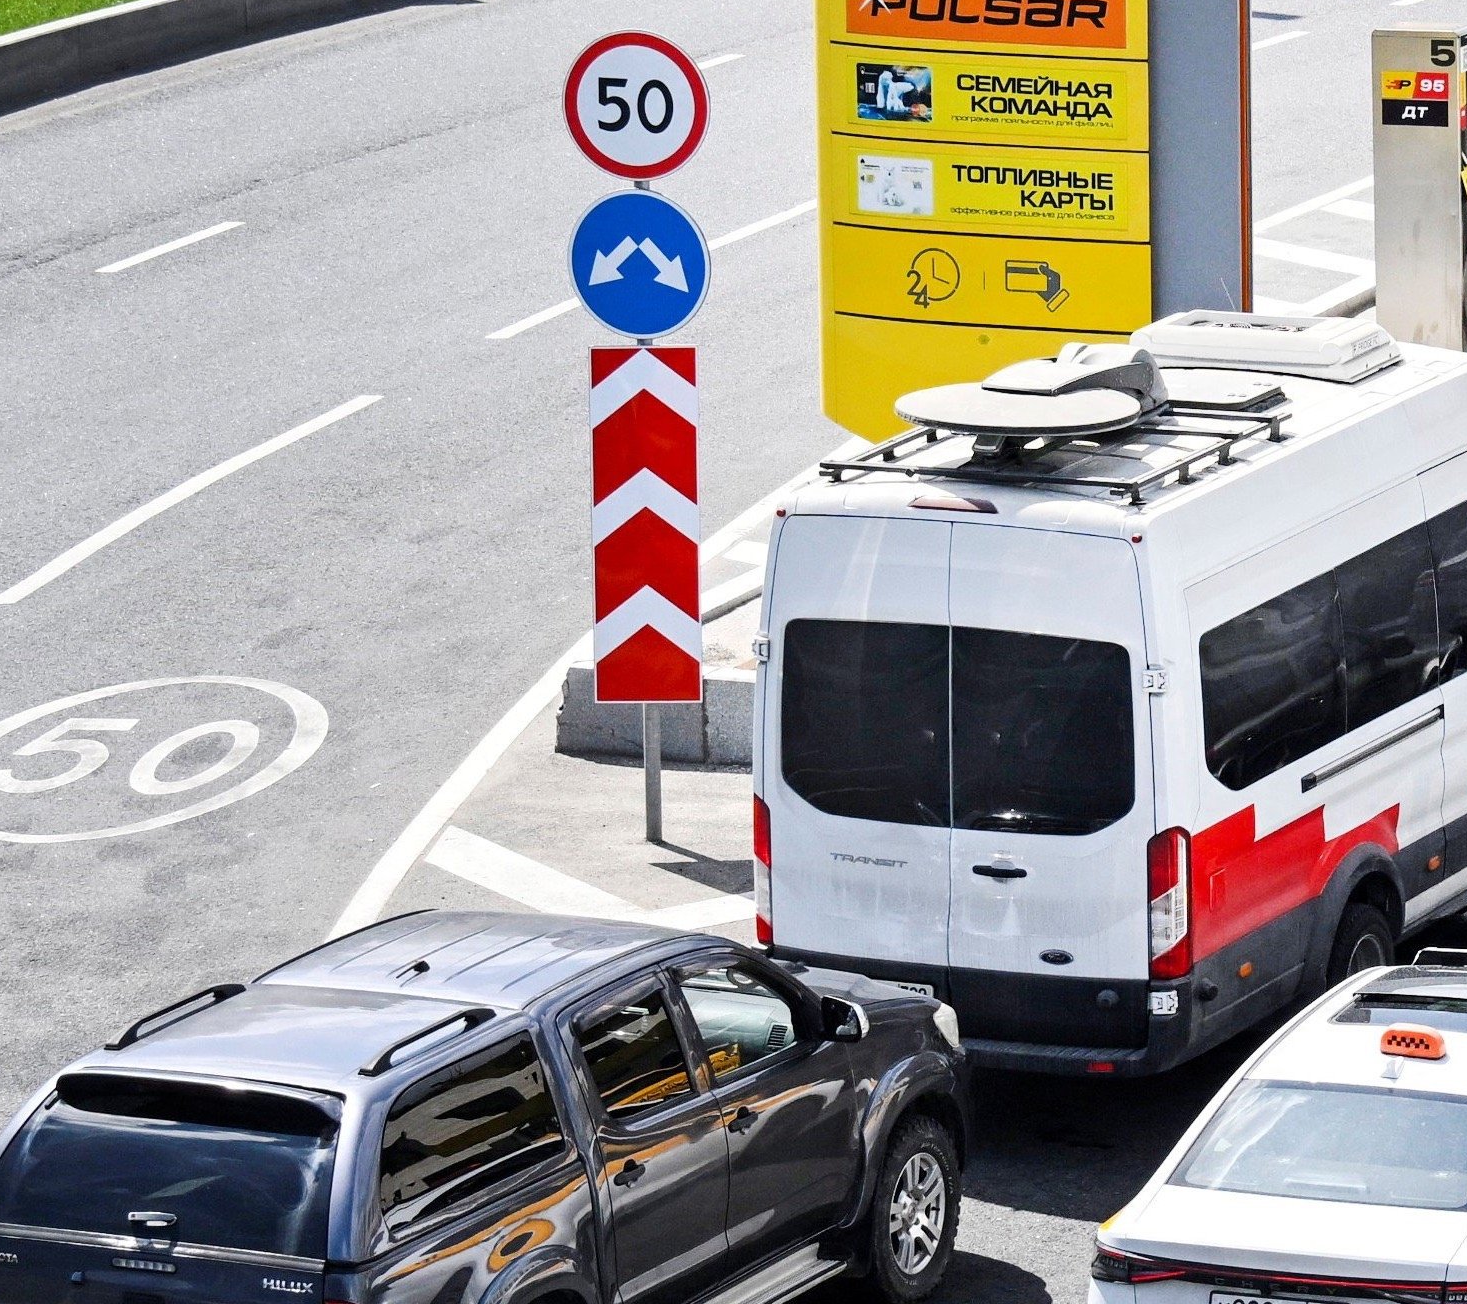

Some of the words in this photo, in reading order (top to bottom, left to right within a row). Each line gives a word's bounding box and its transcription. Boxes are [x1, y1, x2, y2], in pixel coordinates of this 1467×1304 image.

[1430, 39, 1456, 67] 5
[956, 74, 1112, 99] СЕМЕЙНАЯ
[1419, 79, 1445, 93] 95
[597, 77, 674, 134] 50
[971, 95, 1113, 121] КОМАНДА
[1401, 105, 1429, 120] ДТ
[951, 164, 1113, 190] ТОПЛИВНЫЕ
[1020, 189, 1114, 211] КАРТЫ
[907, 270, 930, 308] 24
[830, 852, 908, 868] TRANSIT
[262, 1277, 314, 1294] HILUX
